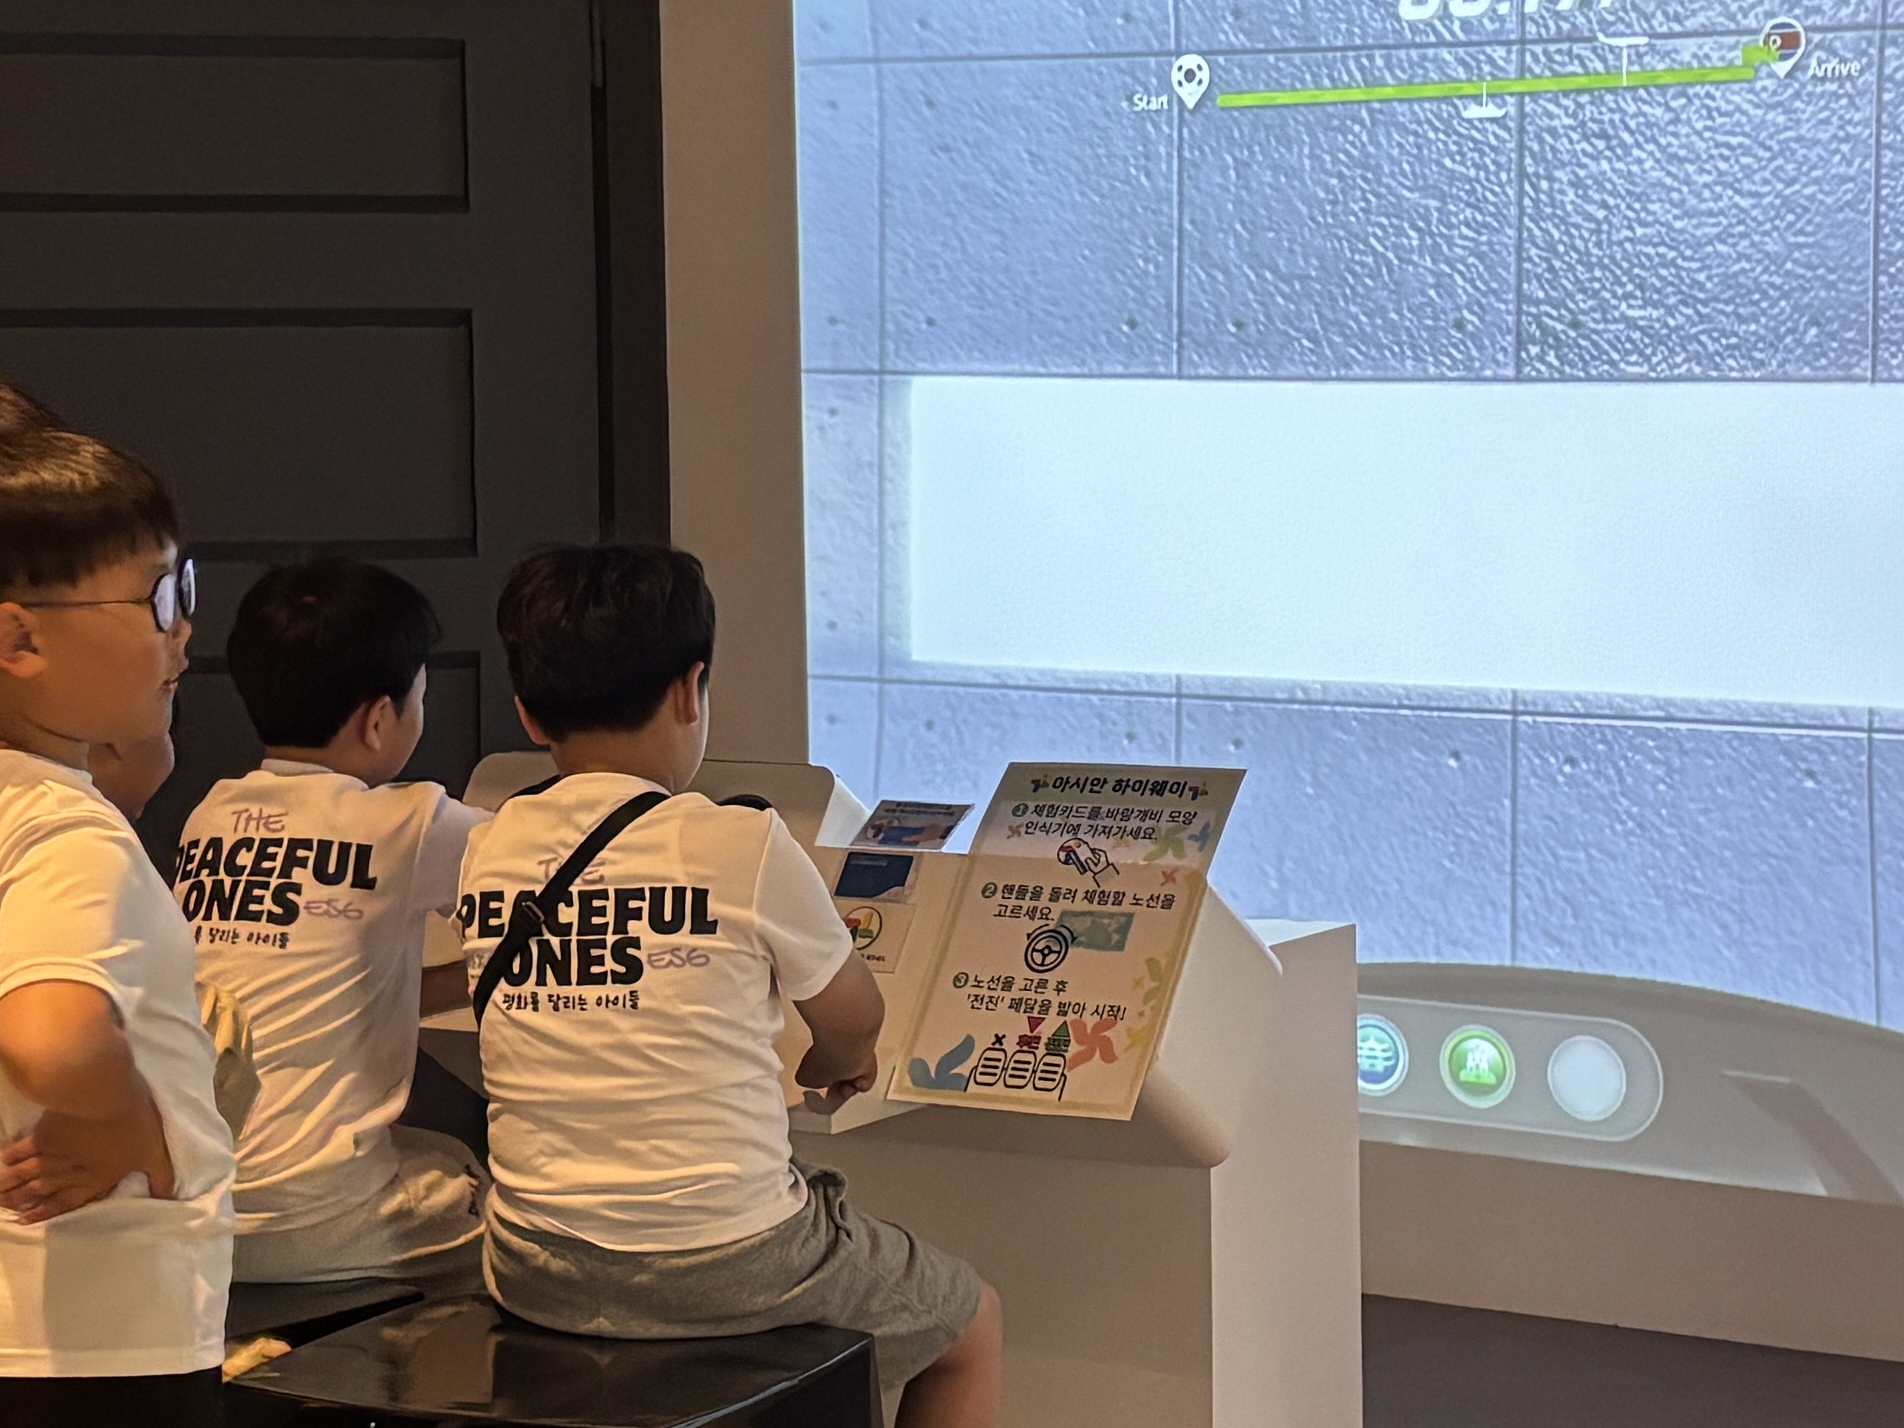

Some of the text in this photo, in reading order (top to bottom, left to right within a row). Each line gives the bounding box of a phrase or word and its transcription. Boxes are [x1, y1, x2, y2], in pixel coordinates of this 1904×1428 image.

[1808, 58, 1862, 79] Arrive
[1133, 93, 1169, 113] Start
[1052, 776, 1189, 798] 아시안 하이웨이
[231, 807, 289, 834] THE
[537, 857, 606, 884] TE
[182, 878, 303, 927] ONES
[502, 936, 644, 987] ONES
[1018, 977, 1049, 994] 고른
[1053, 979, 1069, 996] 후
[502, 990, 640, 1013] 평화를 달리는 아이들
